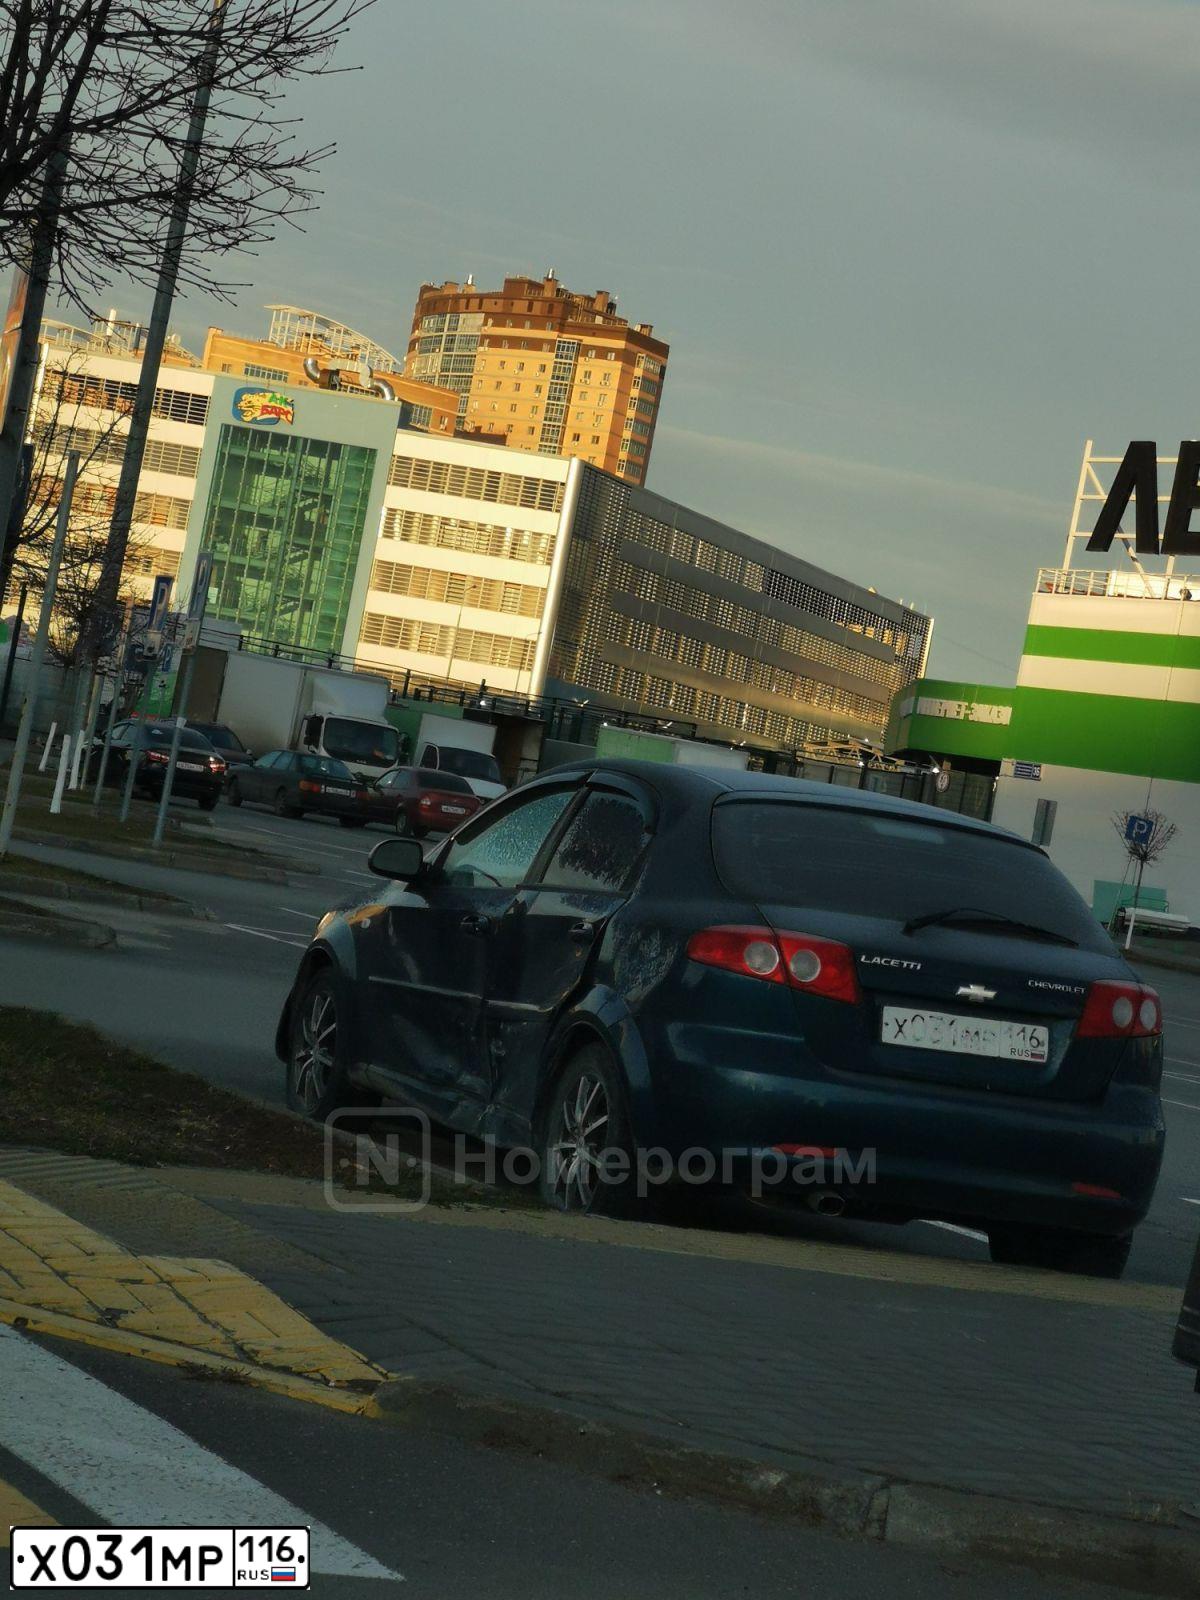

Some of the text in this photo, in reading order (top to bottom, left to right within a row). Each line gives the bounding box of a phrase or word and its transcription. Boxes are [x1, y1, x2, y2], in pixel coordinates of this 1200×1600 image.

[1132, 820, 1147, 839] P
[860, 954, 922, 970] LACETTI
[1028, 979, 1086, 995] CHEVROLET
[1010, 1047, 1030, 1058] RUS
